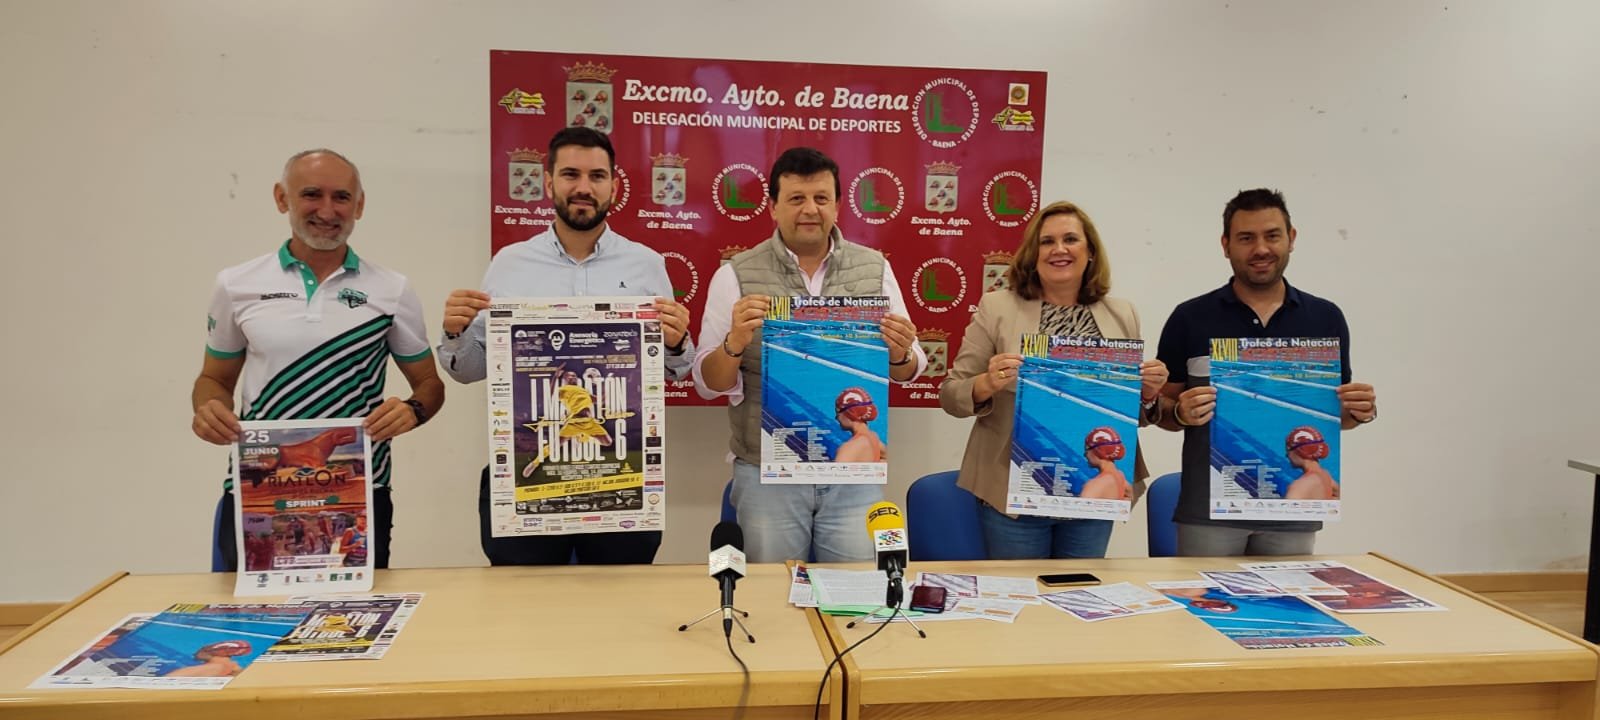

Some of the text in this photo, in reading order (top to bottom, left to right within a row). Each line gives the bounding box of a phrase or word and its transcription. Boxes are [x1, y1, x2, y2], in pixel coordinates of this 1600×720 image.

[622, 79, 910, 111] Excmo. Ayto. de Baena
[632, 111, 902, 133] DELEGACIÓN MUNICIPAL DE DEPORTES
[494, 204, 531, 215] Excmo.
[637, 209, 702, 221] Excmo. Ayto.
[503, 216, 517, 225] de
[646, 220, 693, 230] de Baena
[910, 216, 972, 227] Excmo. Ayto.
[918, 228, 963, 236] de Baena
[827, 296, 841, 307] de
[1084, 337, 1098, 347] de
[1210, 338, 1238, 362] XLVIII
[1275, 338, 1288, 348] de
[664, 390, 688, 398] aena
[909, 391, 921, 399] de
[244, 430, 270, 444] 25
[615, 418, 627, 461] 6
[243, 447, 279, 456] JUNIO
[285, 499, 327, 508] SPRINT
[868, 506, 900, 524] SER
